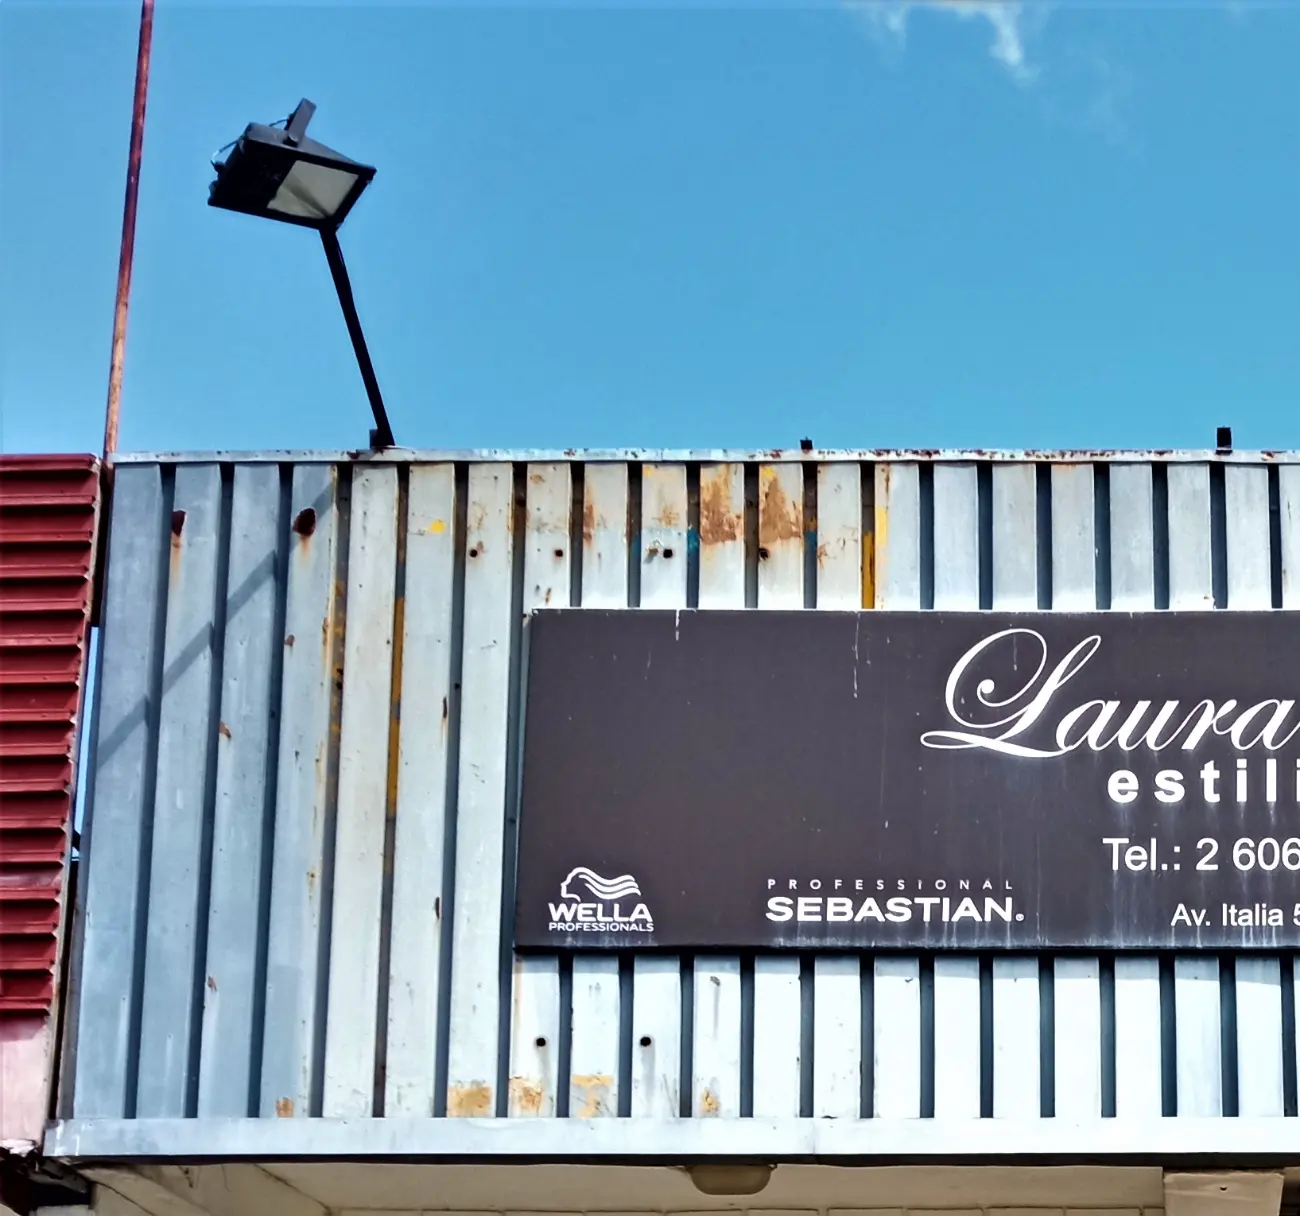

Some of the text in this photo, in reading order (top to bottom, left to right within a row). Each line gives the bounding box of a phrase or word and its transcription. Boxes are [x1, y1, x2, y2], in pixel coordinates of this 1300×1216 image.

[1102, 837, 1181, 871] Tel.:
[1195, 837, 1219, 871] 2
[767, 879, 1013, 890] PROFESSIONAL
[548, 902, 653, 922] WELLA
[1170, 903, 1211, 926] Av.
[1222, 903, 1284, 926] Italia
[548, 922, 655, 932] PROFESSIONALS
